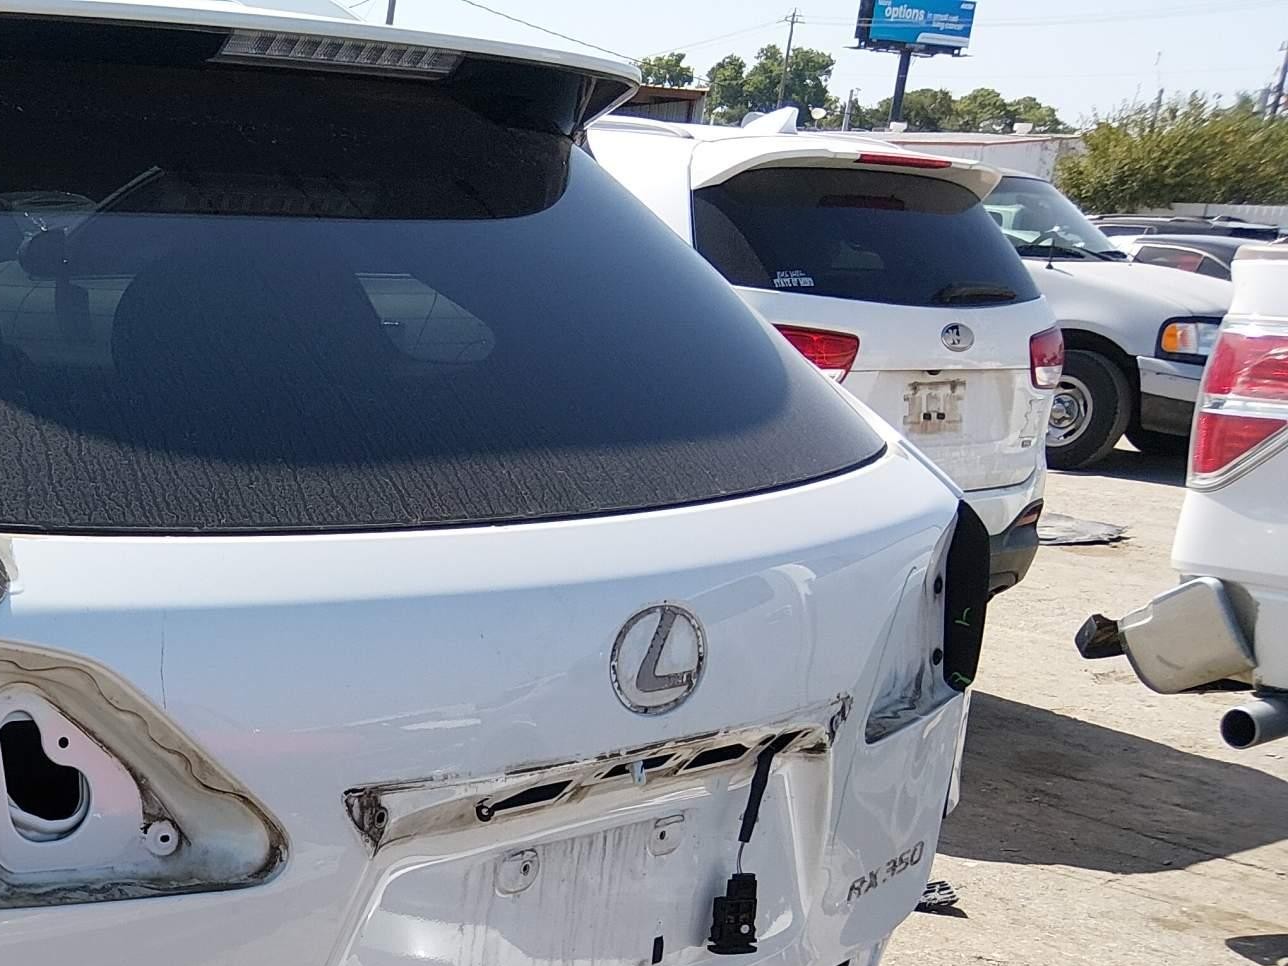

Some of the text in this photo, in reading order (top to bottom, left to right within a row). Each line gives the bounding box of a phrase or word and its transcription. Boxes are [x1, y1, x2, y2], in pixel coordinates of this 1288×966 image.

[885, 4, 925, 21] options
[847, 841, 925, 902] RX 350
